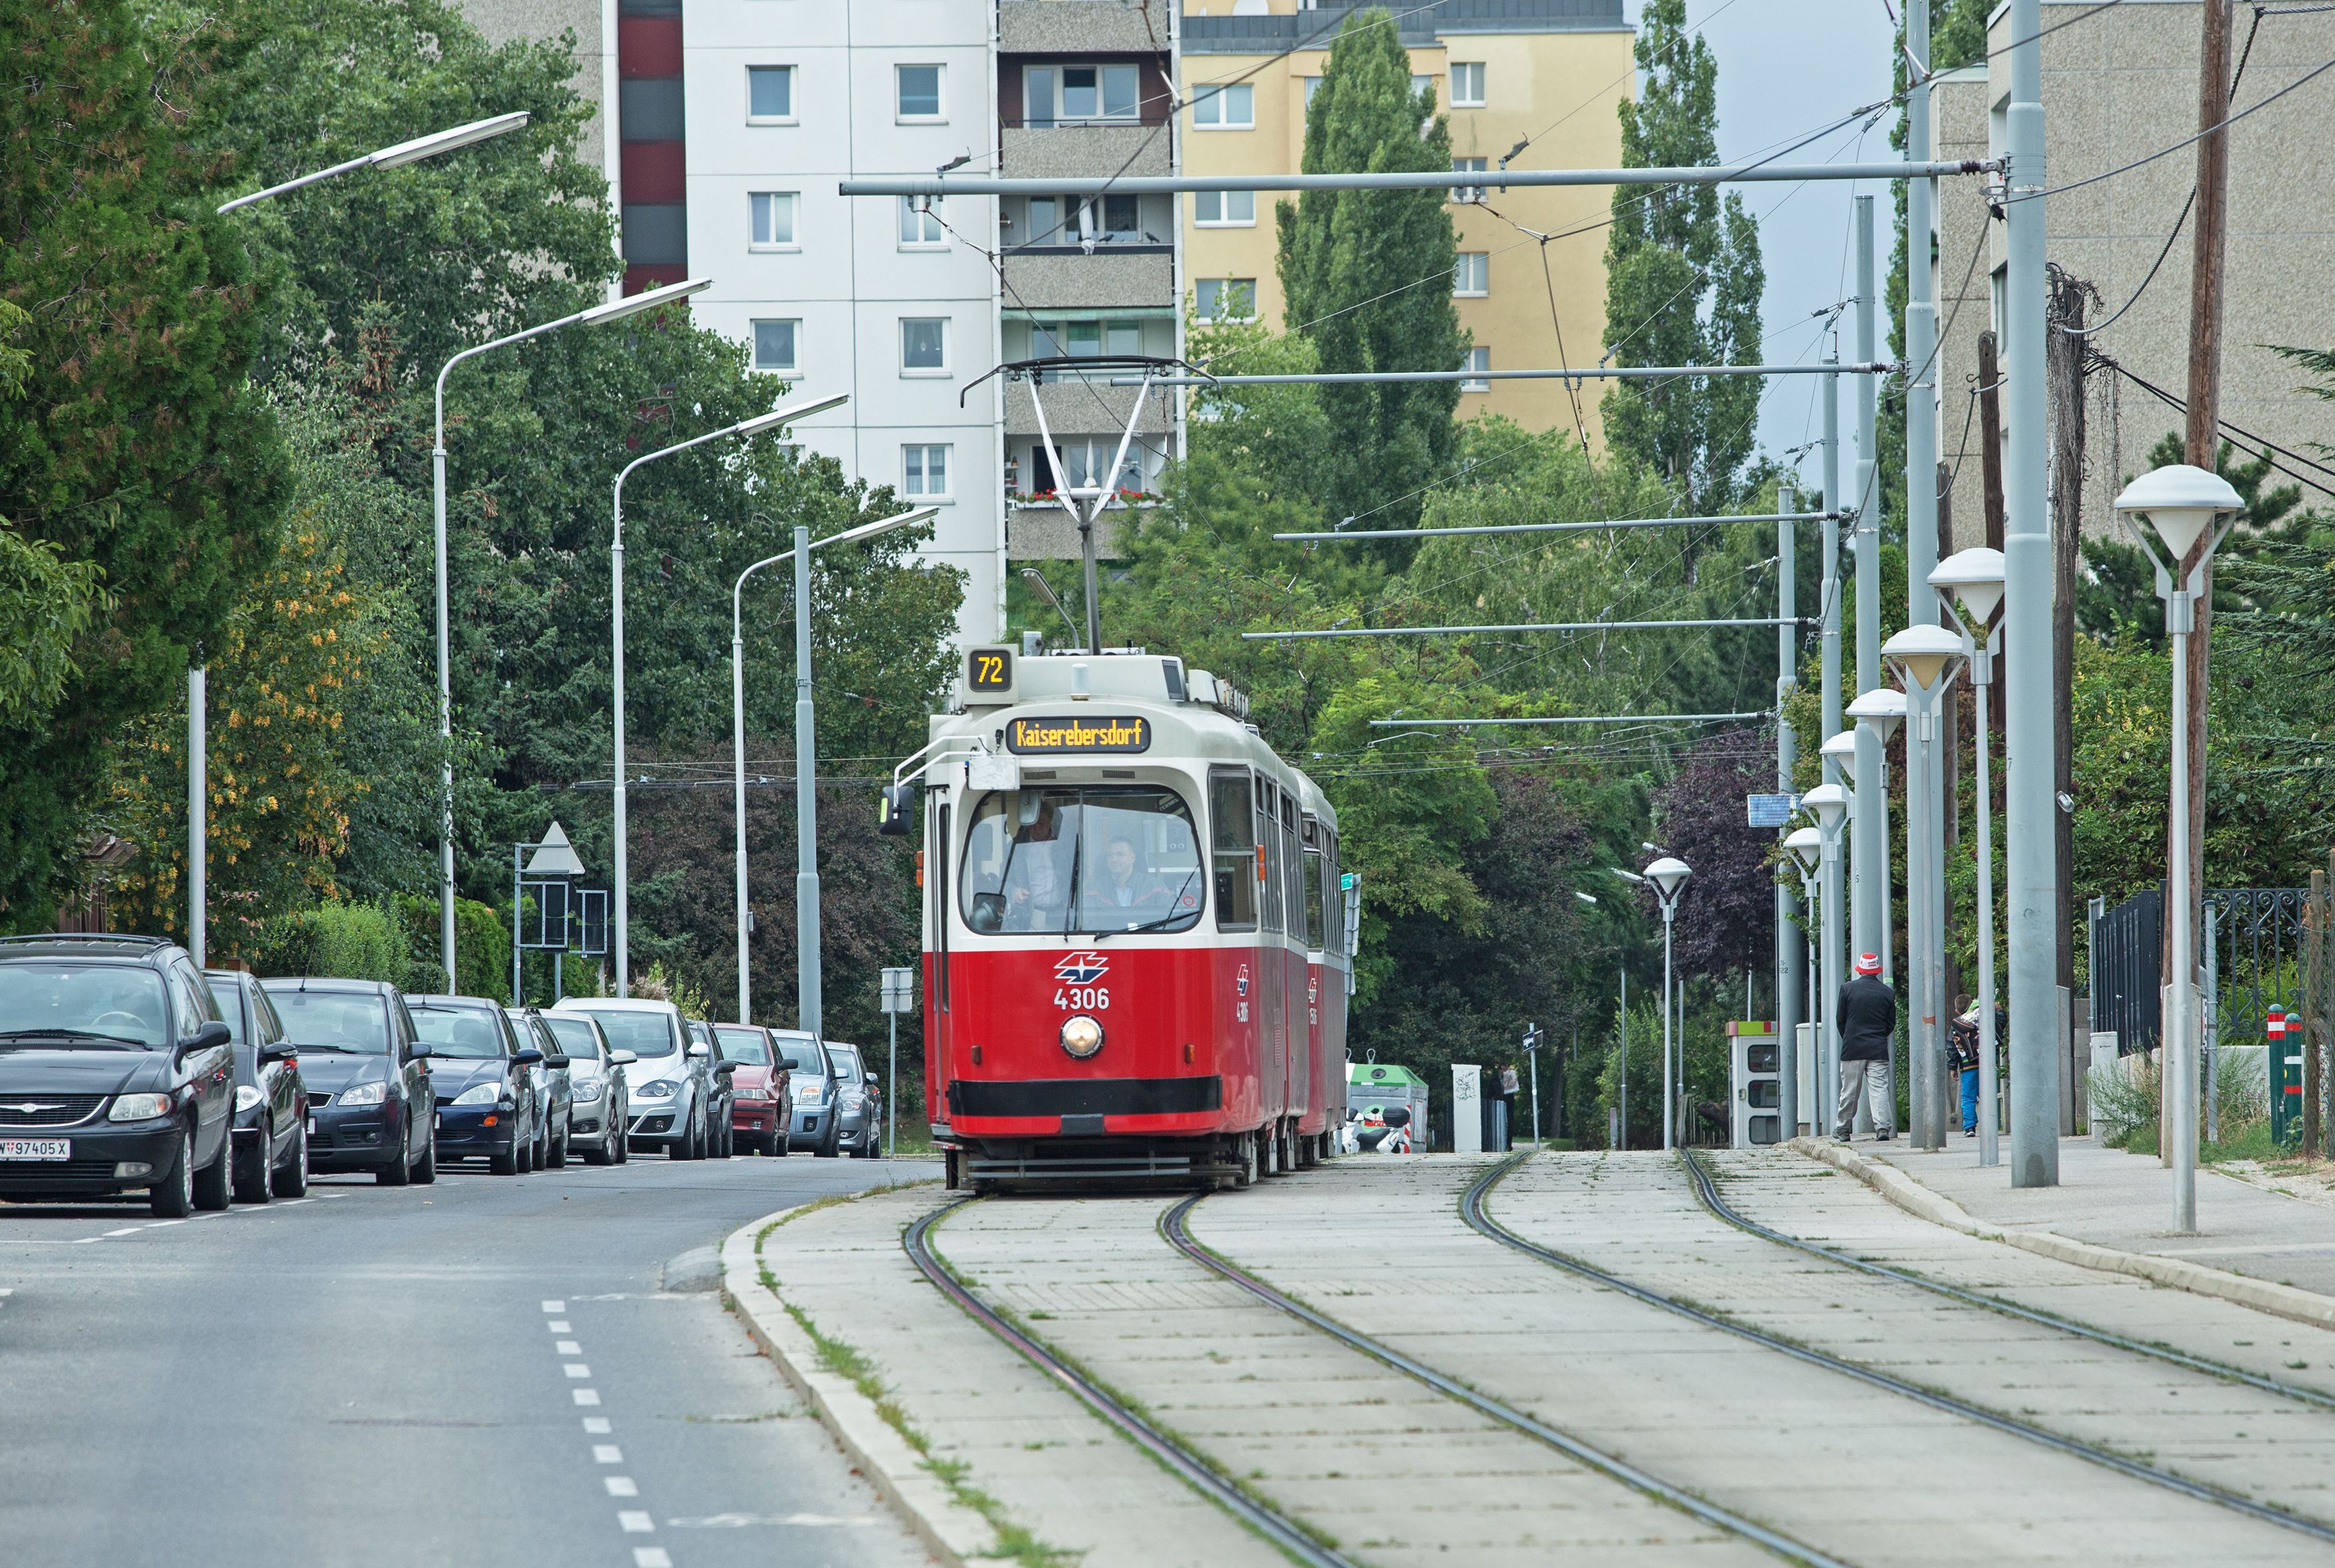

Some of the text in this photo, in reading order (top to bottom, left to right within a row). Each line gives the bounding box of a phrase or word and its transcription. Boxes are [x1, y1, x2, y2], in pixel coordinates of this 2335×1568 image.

[978, 656, 1003, 683] 72
[1016, 719, 1142, 746] Kaiserebersdorf
[1053, 988, 1109, 1010] 4306
[1236, 1001, 1248, 1022] 4306
[15, 1142, 55, 1154] 97405
